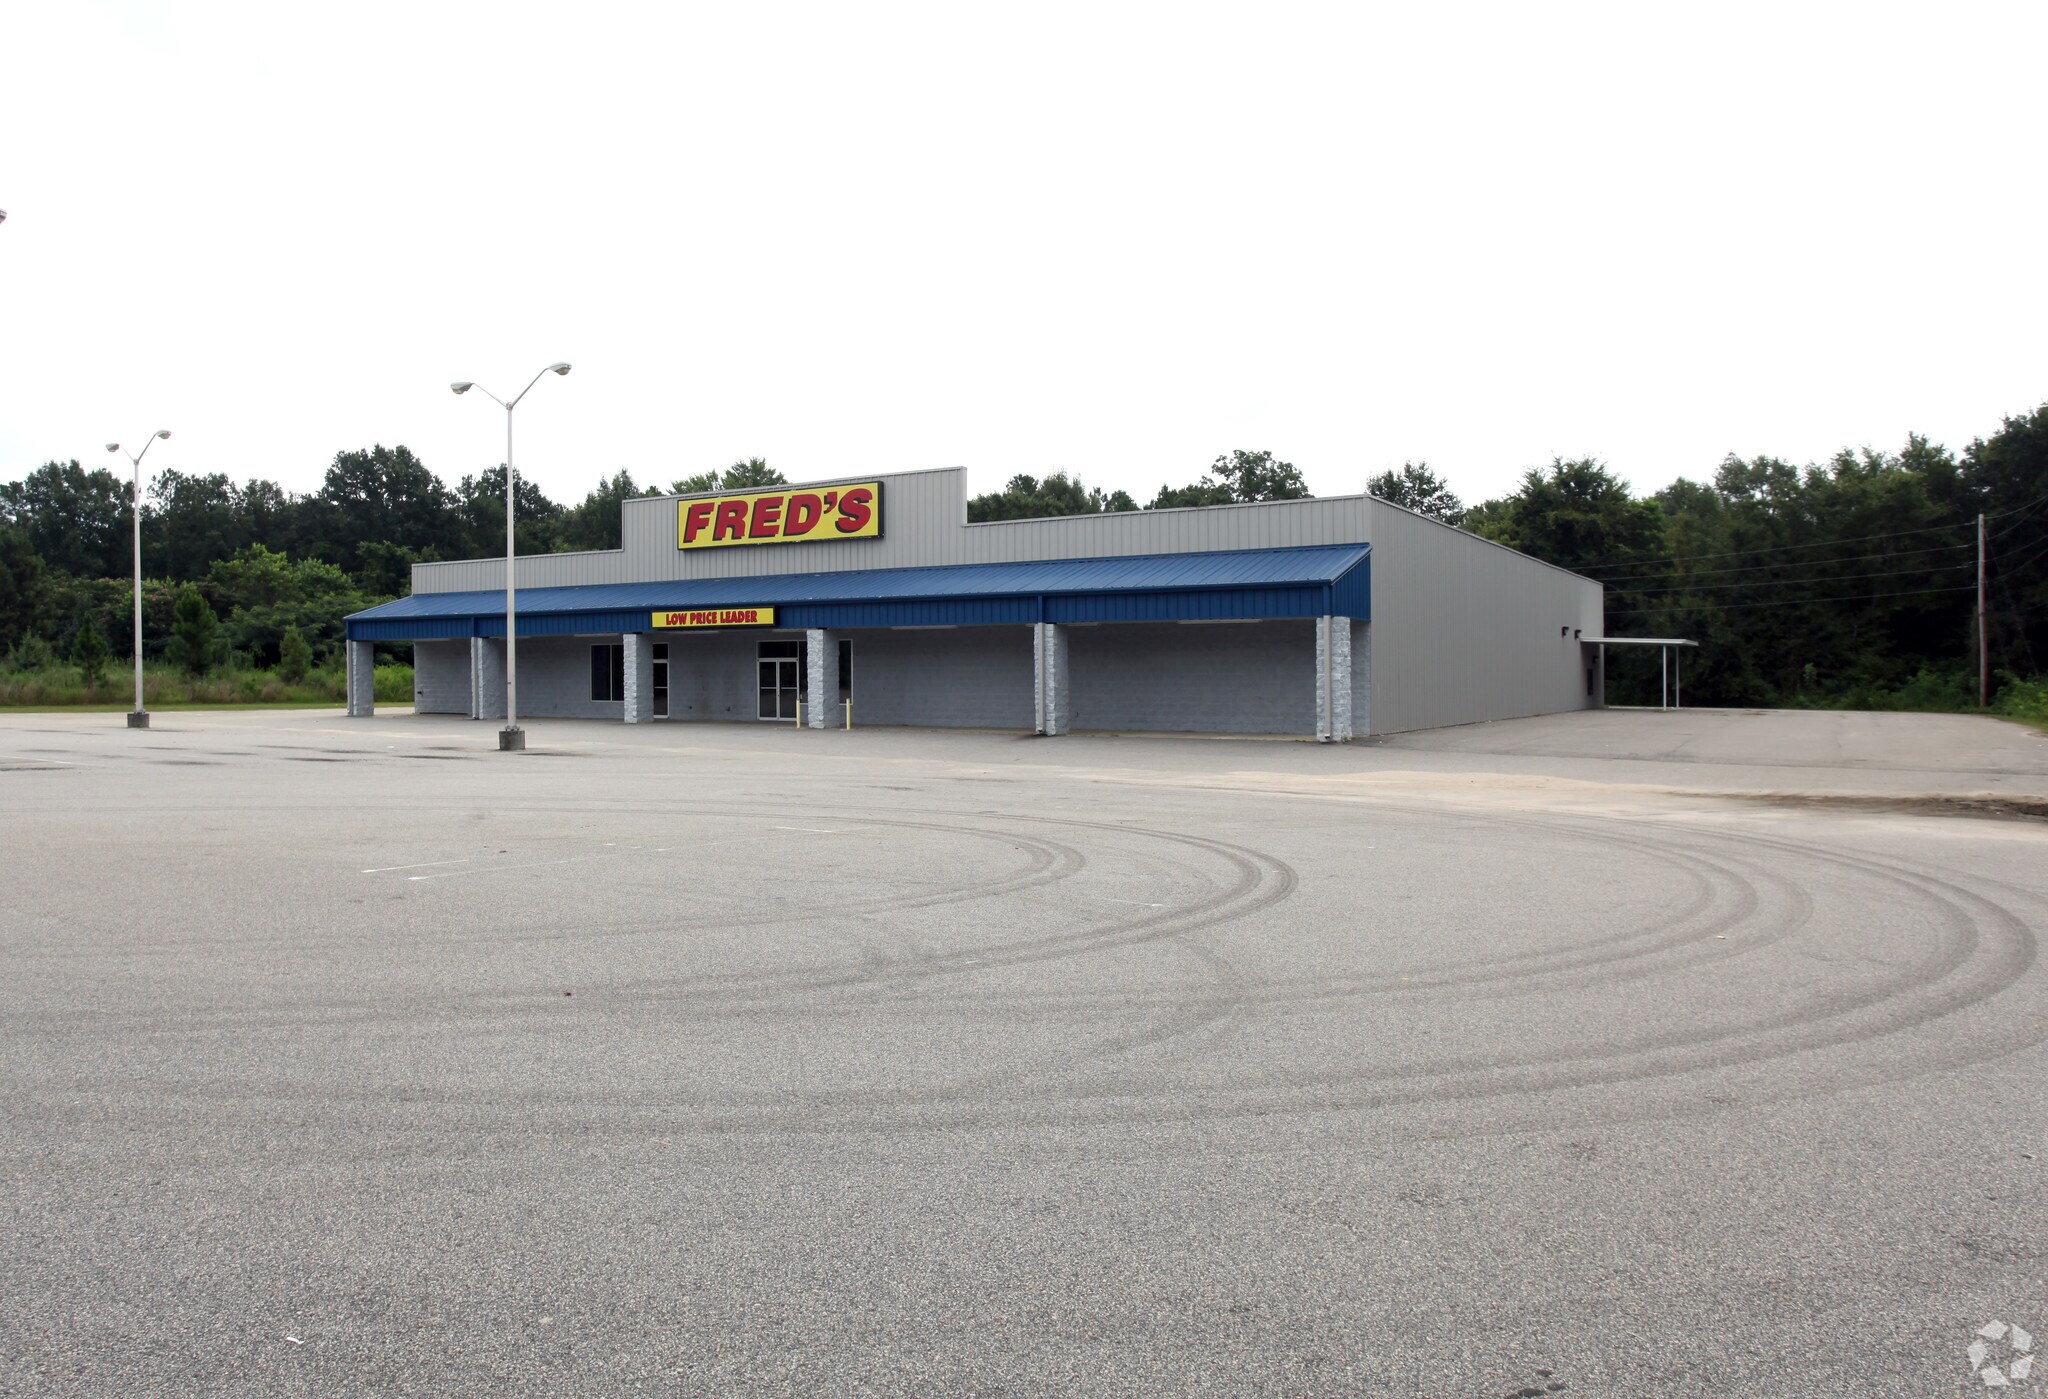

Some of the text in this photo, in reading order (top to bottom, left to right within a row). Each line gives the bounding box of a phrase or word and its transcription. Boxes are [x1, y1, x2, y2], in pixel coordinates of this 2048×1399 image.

[683, 488, 873, 543] FRED'S
[666, 610, 758, 625] LOW PRICE LEADER
